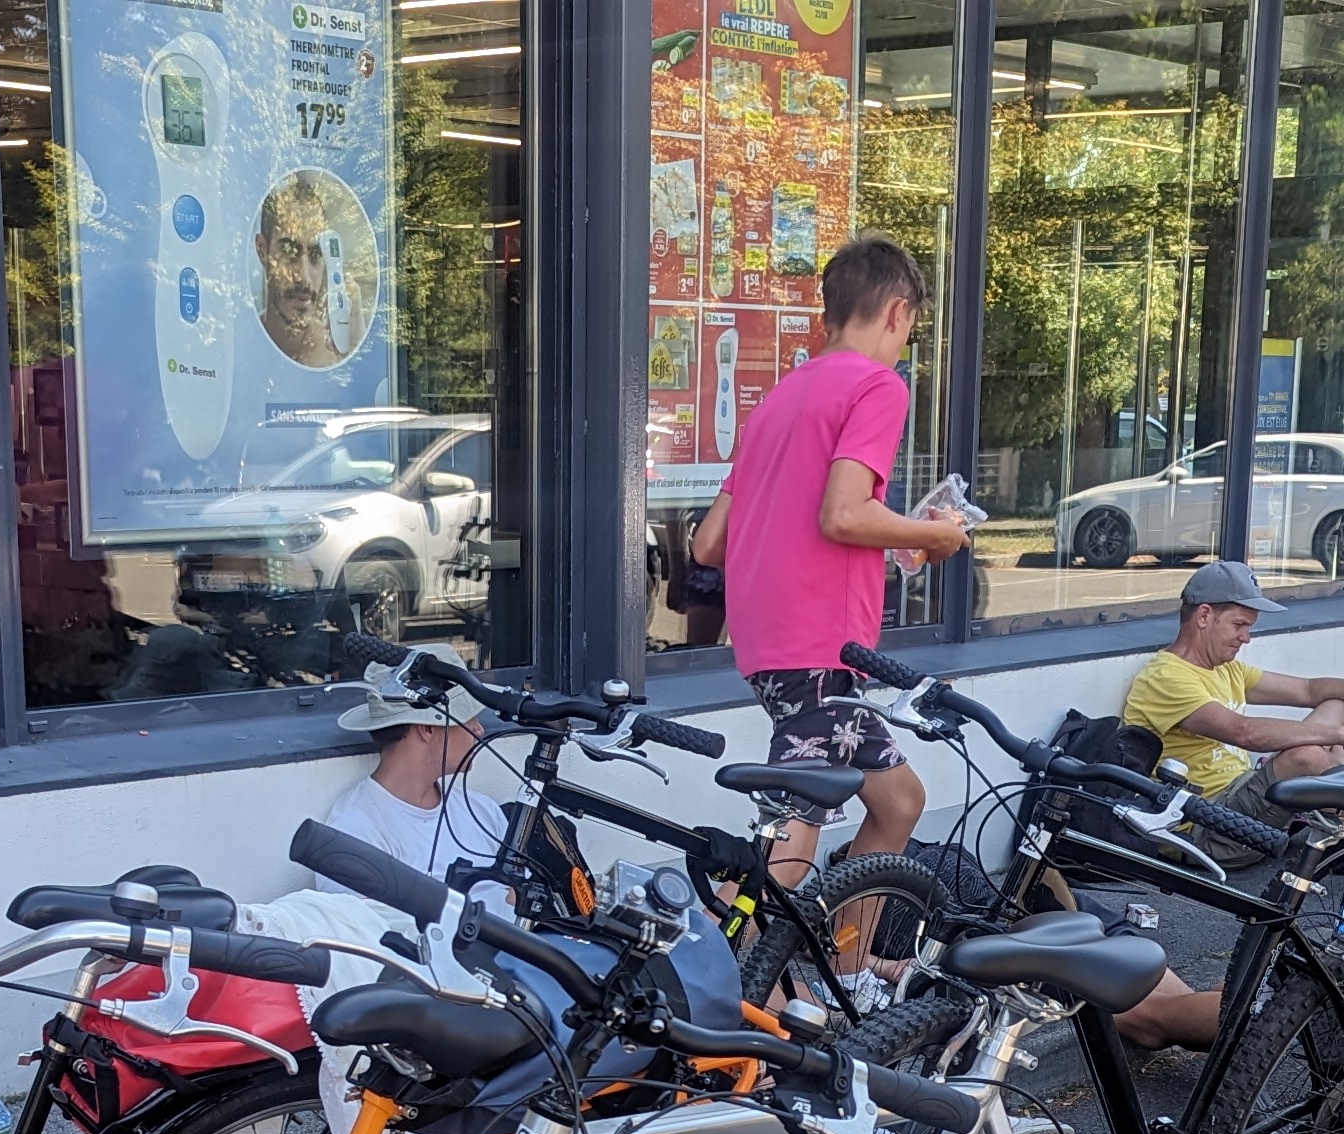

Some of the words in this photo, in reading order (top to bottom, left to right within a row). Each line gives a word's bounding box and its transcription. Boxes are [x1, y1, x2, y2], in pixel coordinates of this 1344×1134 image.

[310, 12, 327, 29] Dr.
[330, 16, 363, 34] Senst
[721, 15, 730, 27] le
[731, 18, 750, 32] vrai
[750, 20, 790, 40] REPÈRE
[290, 39, 355, 60] THERMOMÈTRE
[712, 29, 755, 50] CONTRE
[757, 36, 798, 57] l'inflation
[291, 59, 331, 76] FRONTAL
[176, 211, 200, 225] START
[179, 364, 190, 375] Dr.
[192, 366, 217, 378] Senst
[650, 359, 672, 380] Leffe
[271, 410, 295, 423] SANS
[791, 1101, 812, 1114] A3
